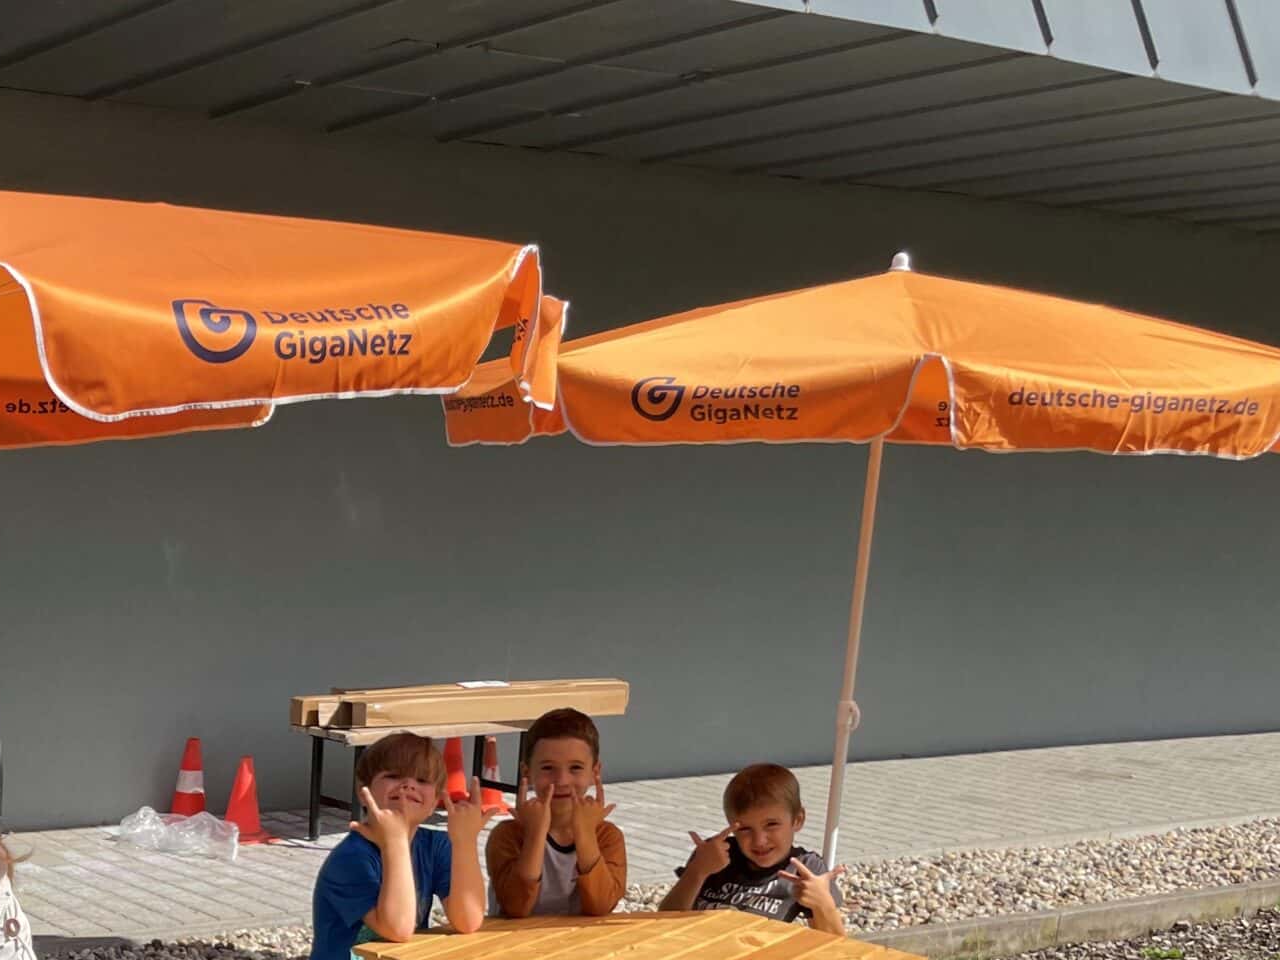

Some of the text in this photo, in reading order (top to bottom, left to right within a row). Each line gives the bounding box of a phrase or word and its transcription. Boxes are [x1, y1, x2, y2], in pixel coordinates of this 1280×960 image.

[261, 303, 410, 324] Deutsche
[274, 328, 413, 364] GigaNetz
[691, 382, 801, 400] Deutsche
[1007, 386, 1260, 416] deutsche-giganetz.de
[690, 404, 799, 425] GigaNetz
